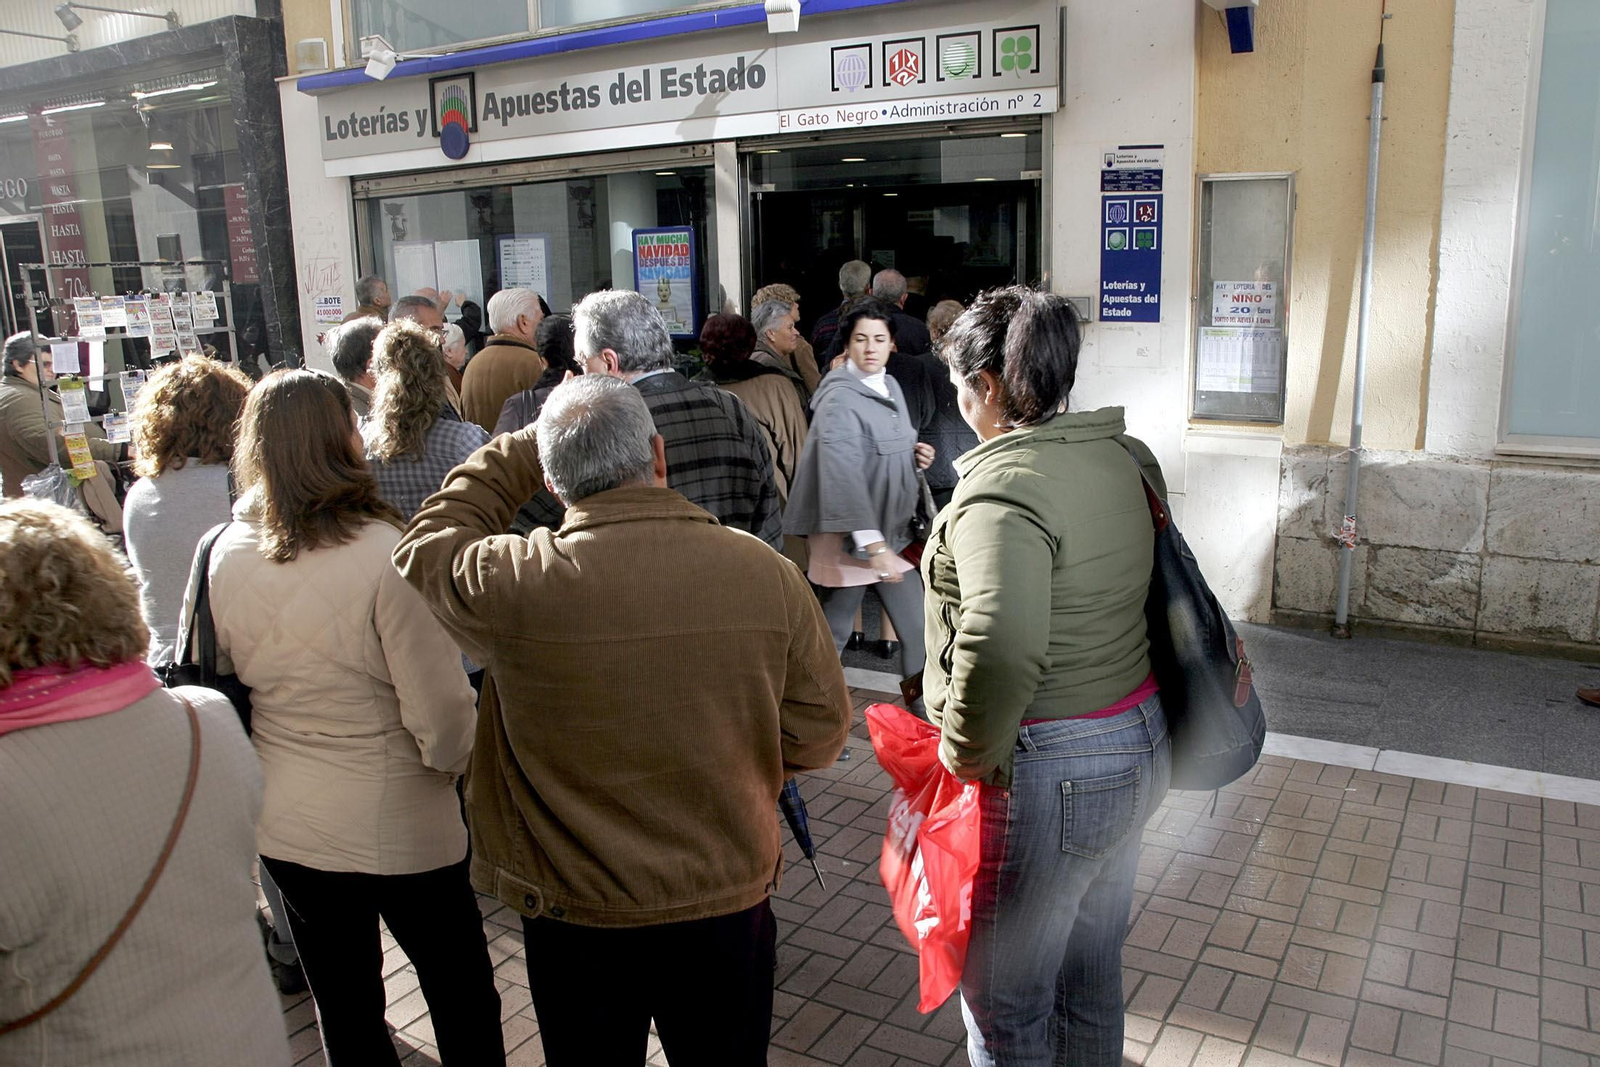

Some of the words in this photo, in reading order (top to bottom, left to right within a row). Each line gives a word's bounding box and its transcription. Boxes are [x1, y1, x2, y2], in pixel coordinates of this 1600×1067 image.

[325, 106, 410, 141] Loterías
[415, 108, 429, 138] y
[482, 81, 601, 127] Apuestas
[608, 69, 651, 106] del
[660, 56, 767, 100] Estado
[780, 113, 792, 128] El
[797, 112, 829, 128] Gato
[836, 108, 879, 127] Negro
[889, 96, 1000, 119] Administración
[1032, 94, 1042, 108] 2
[50, 185, 71, 197] HASTA
[52, 203, 75, 215] HASTA
[51, 223, 81, 237] HASTA
[638, 236, 656, 246] HAY
[656, 234, 689, 245] MUCHA
[52, 249, 86, 264] HASTA
[638, 244, 690, 259] NAVIDAD
[677, 257, 690, 266] DE
[639, 266, 690, 280] NAVIDAD
[1103, 280, 1138, 290] Loterías
[1139, 283, 1146, 292] y
[1103, 294, 1142, 305] Apuestas
[1144, 294, 1158, 303] del
[1231, 292, 1262, 303] NIÑO
[1103, 308, 1132, 317] Estado
[1229, 306, 1251, 314] 20
